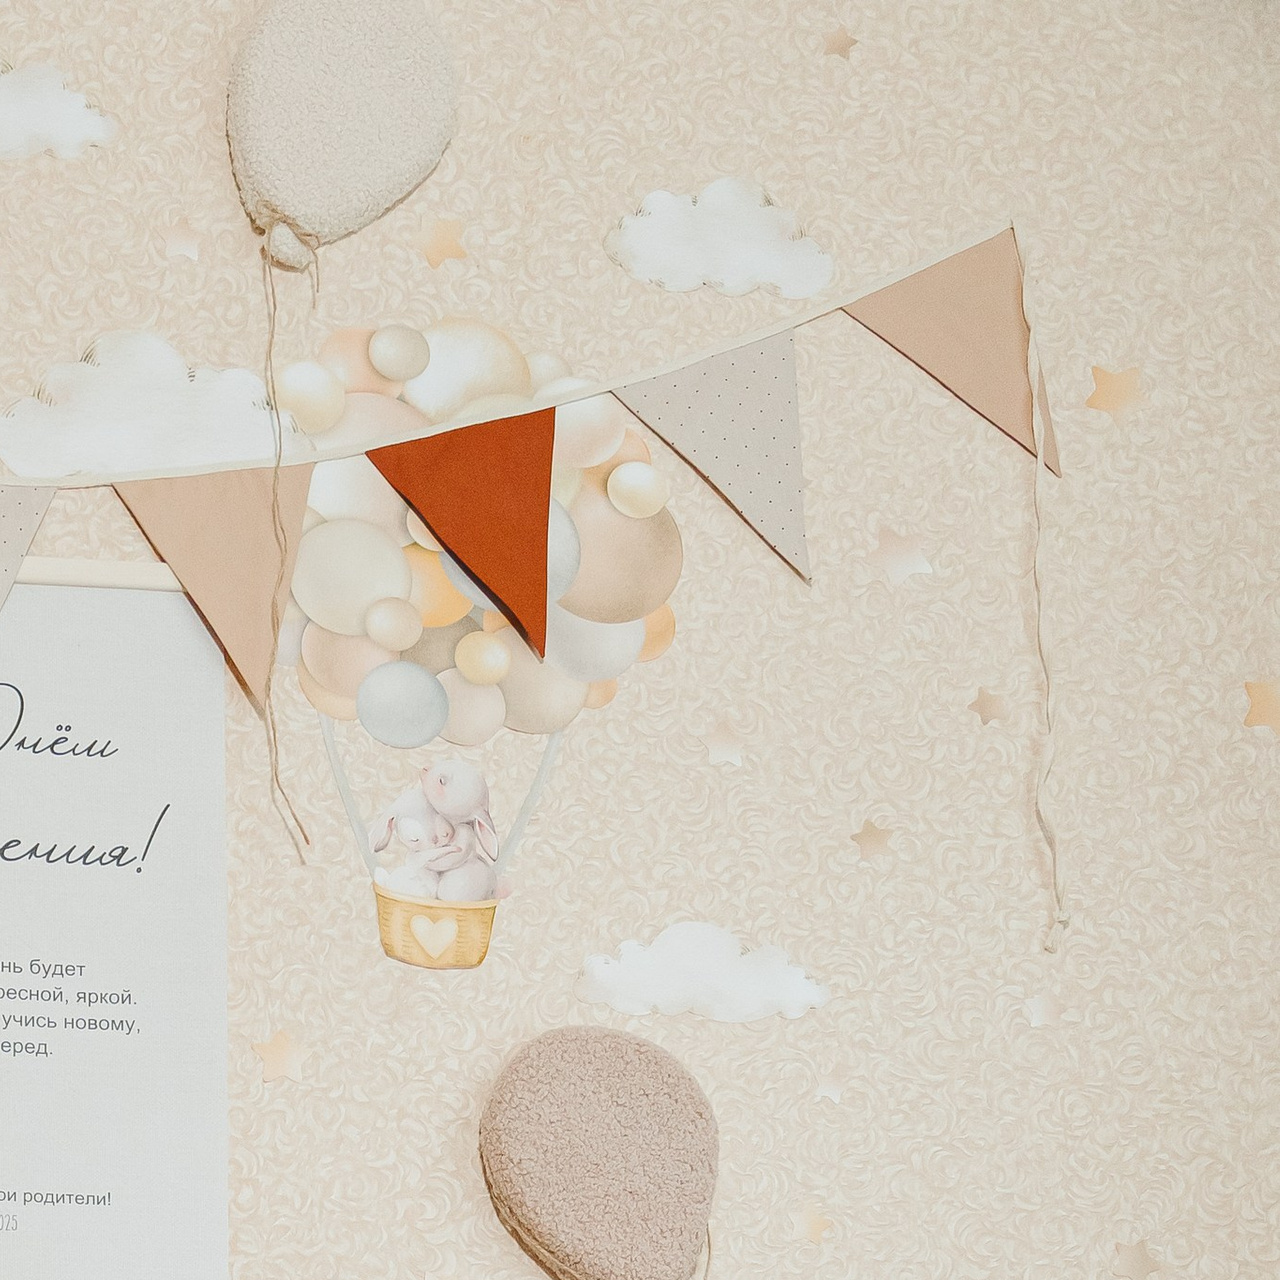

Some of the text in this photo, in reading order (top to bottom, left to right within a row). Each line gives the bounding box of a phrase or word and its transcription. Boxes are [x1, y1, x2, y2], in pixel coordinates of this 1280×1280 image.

[29, 959, 86, 978] будет
[76, 990, 137, 1007] яркой.
[1, 1015, 57, 1029] учись
[64, 1018, 140, 1035] новому,
[23, 1192, 111, 1205] родители!
